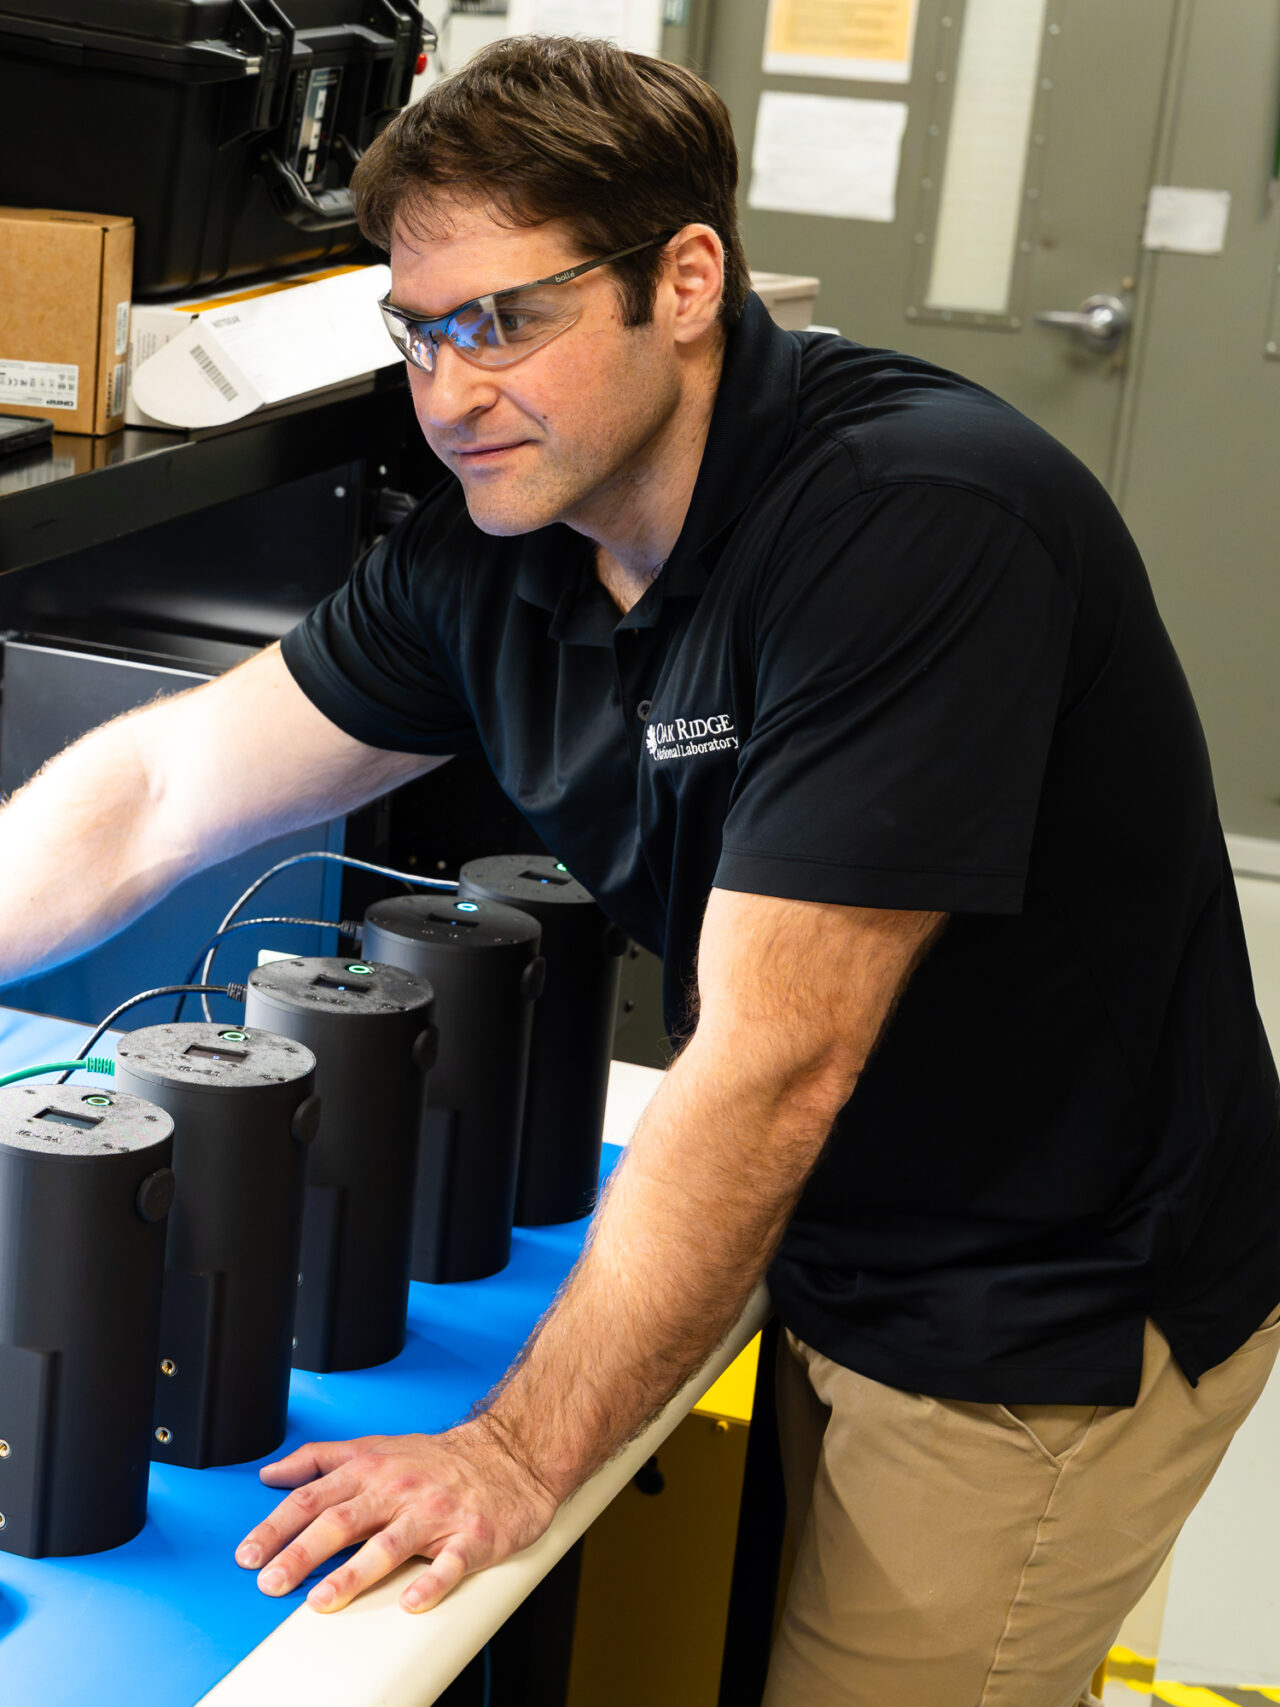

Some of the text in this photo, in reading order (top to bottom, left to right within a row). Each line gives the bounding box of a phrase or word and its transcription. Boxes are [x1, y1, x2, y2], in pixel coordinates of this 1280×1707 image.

[656, 714, 734, 744] OAK RIDGE
[681, 736, 738, 757] Laboratory
